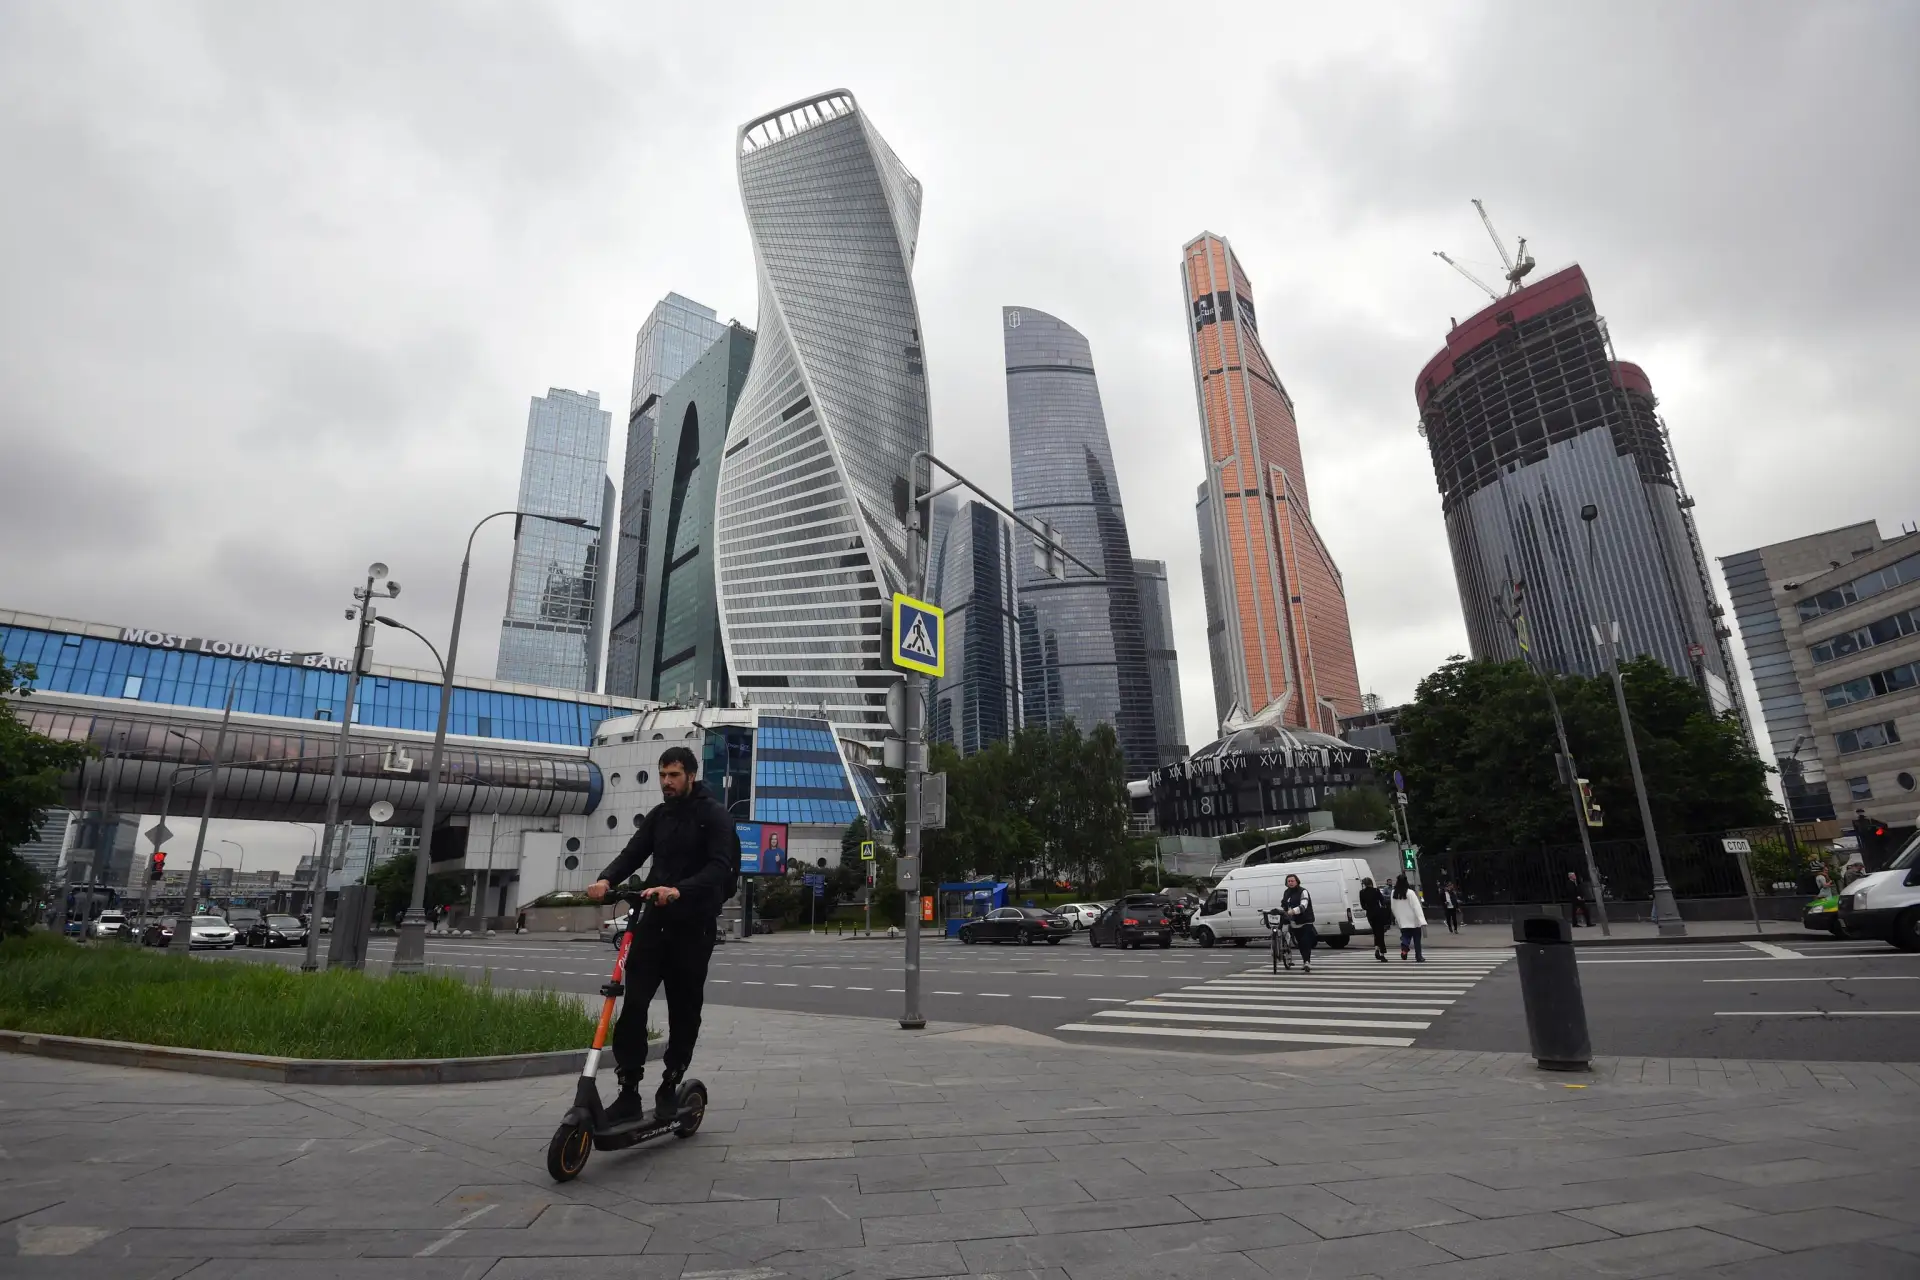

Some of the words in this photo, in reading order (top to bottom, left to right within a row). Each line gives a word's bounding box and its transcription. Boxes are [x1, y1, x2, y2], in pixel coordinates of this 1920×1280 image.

[123, 628, 192, 649] MOST
[199, 639, 293, 664] LOUNGE
[303, 655, 348, 671] BAR
[1727, 841, 1748, 851] СТОП
